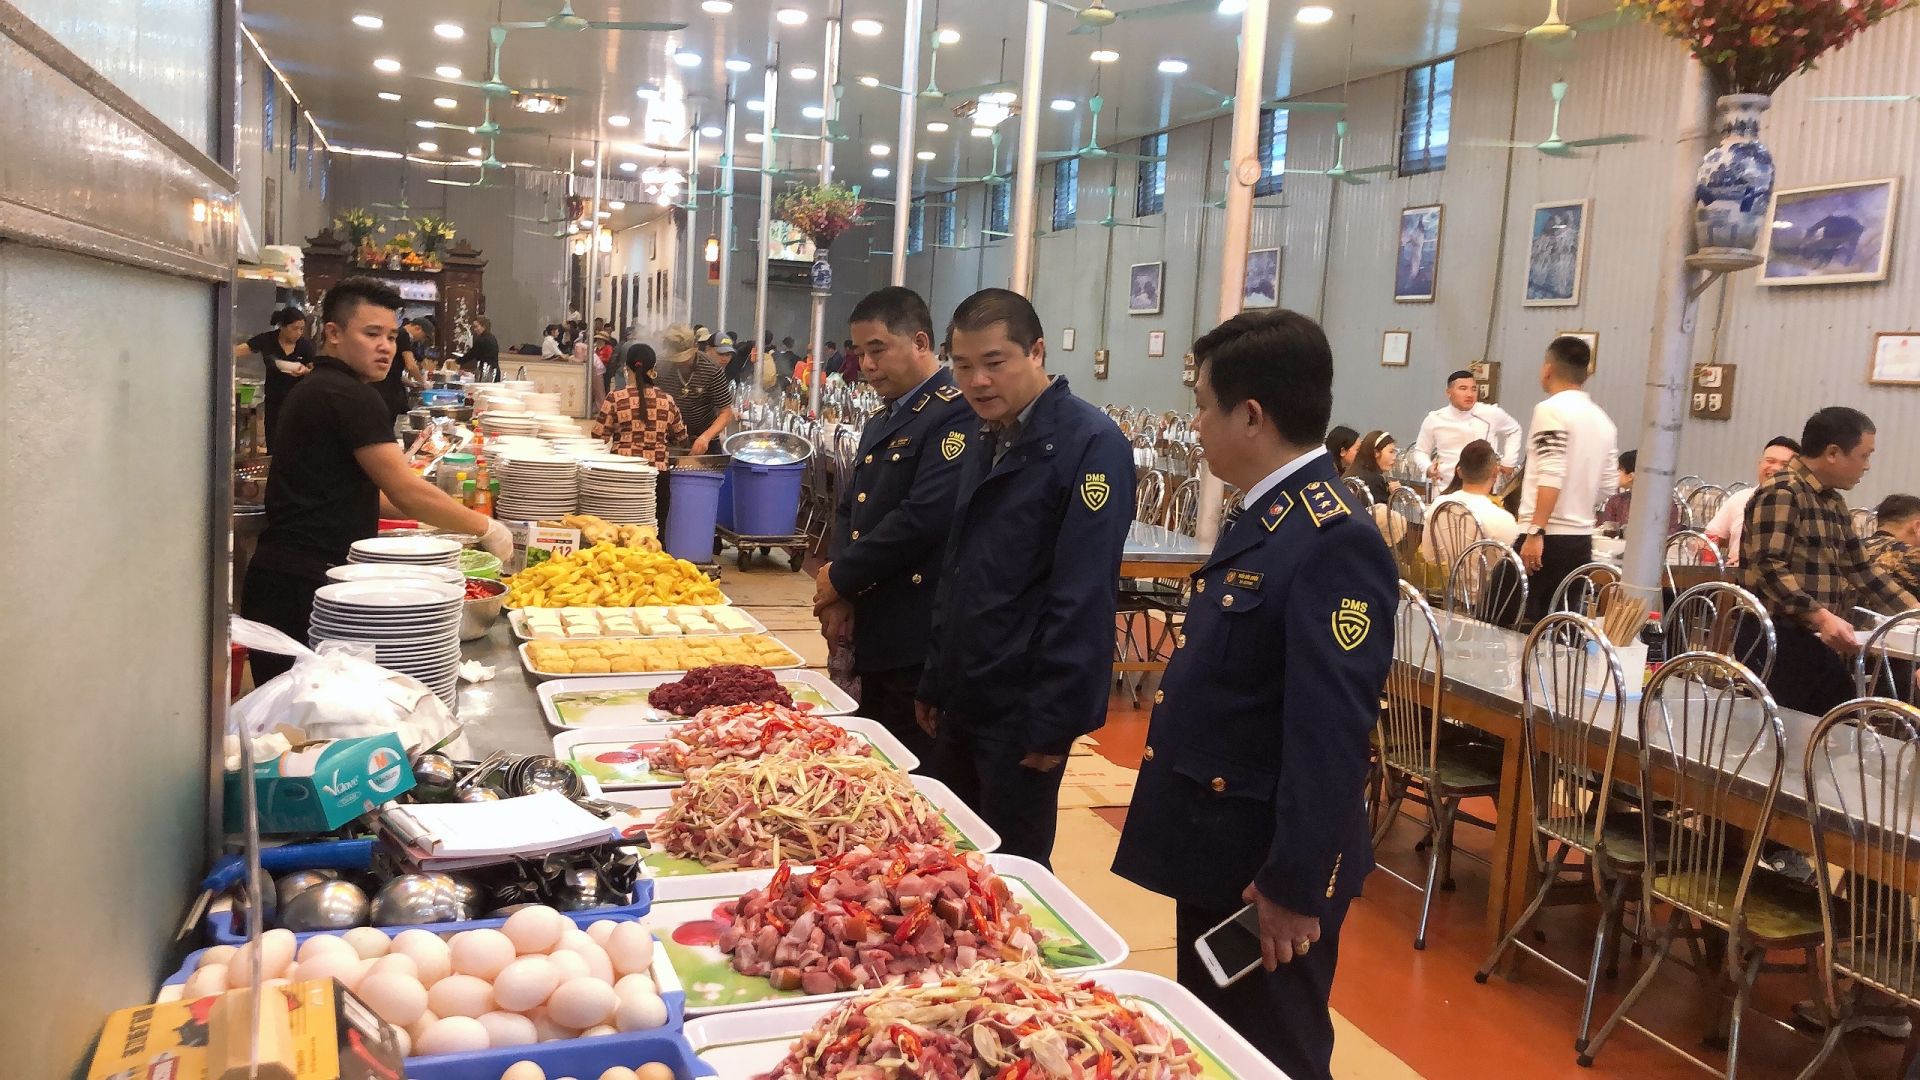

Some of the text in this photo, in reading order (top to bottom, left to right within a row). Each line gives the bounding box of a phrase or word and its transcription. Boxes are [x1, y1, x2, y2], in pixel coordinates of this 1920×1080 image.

[948, 431, 966, 440] DMS
[1085, 473, 1106, 482] DMS
[1341, 598, 1369, 613] DMS
[373, 751, 389, 769] M
